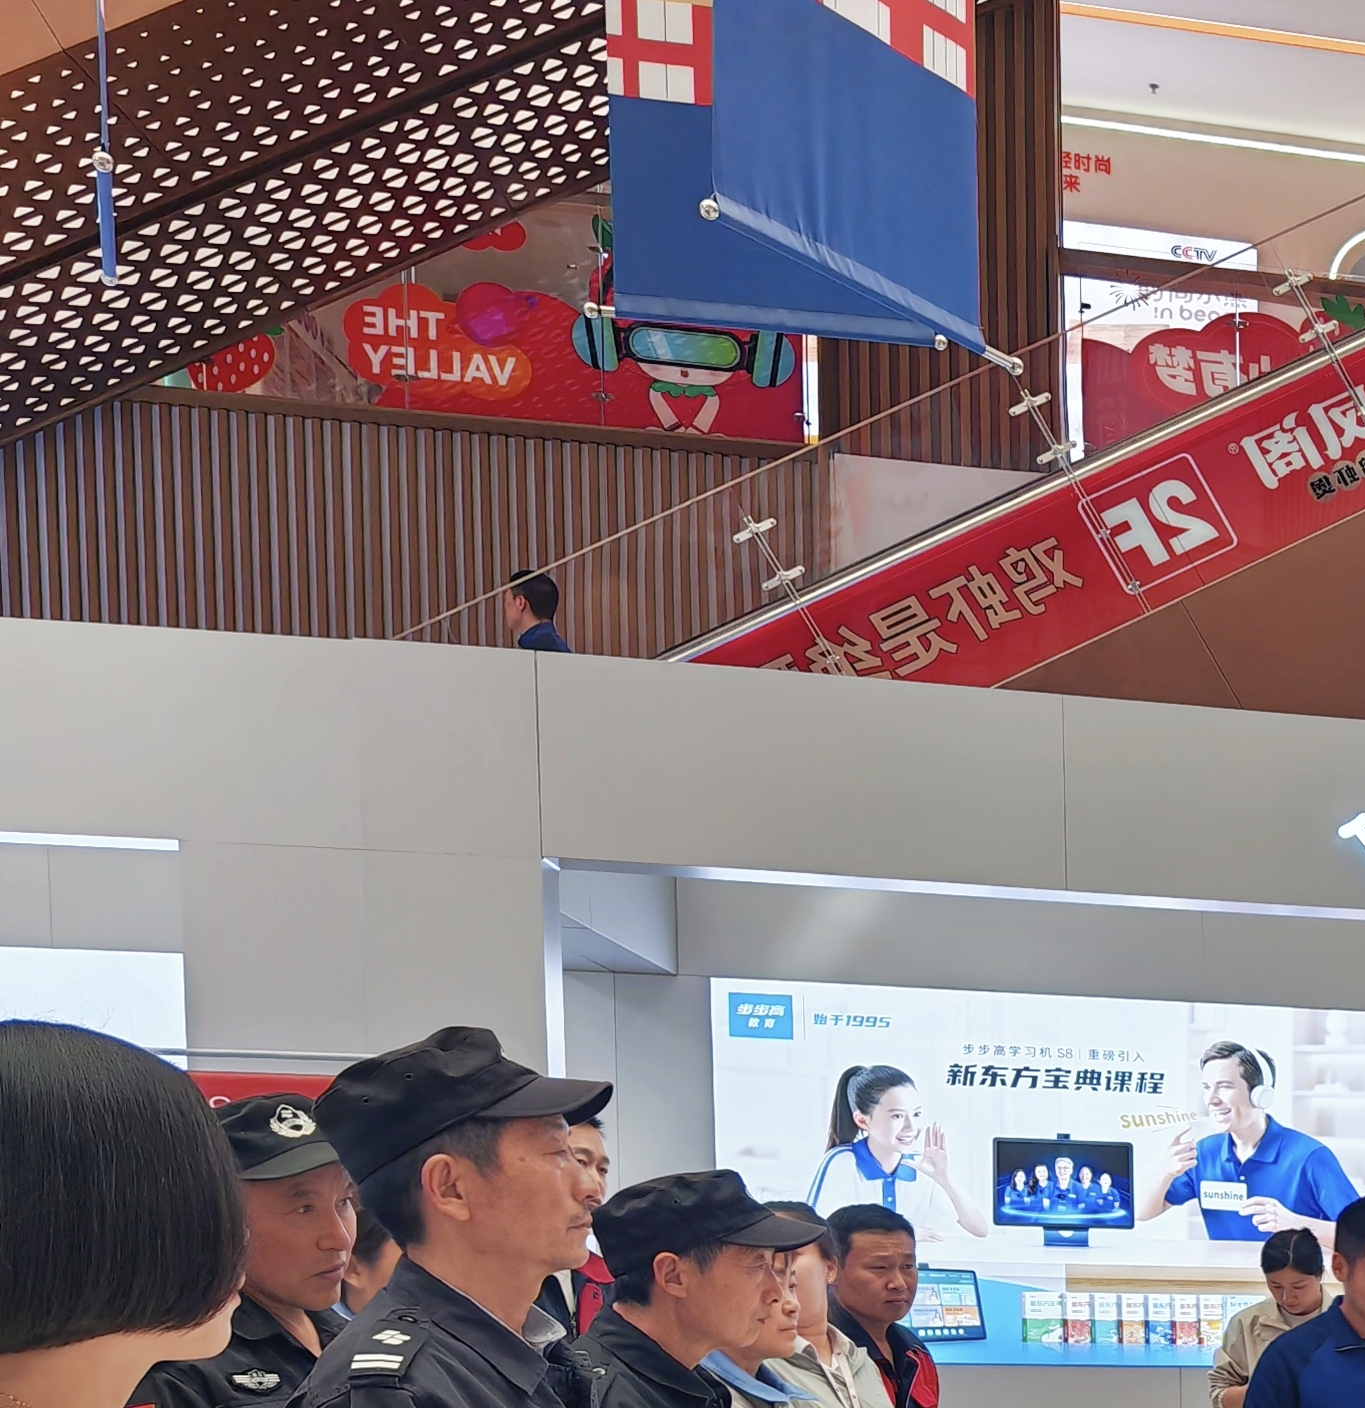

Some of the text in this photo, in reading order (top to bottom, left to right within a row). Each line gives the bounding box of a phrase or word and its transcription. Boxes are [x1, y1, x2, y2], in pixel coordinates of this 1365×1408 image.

[1171, 245, 1217, 262] CCTV
[736, 1001, 786, 1018] 步步高
[747, 1016, 776, 1029] 教育
[813, 1013, 892, 1029] 始于1995
[961, 1043, 1145, 1063] 步步高学习机 S8 重磅引入
[946, 1063, 1165, 1096] 新东方宝典课程
[1120, 1107, 1197, 1131] sunshine
[1203, 1188, 1244, 1202] sunshine
